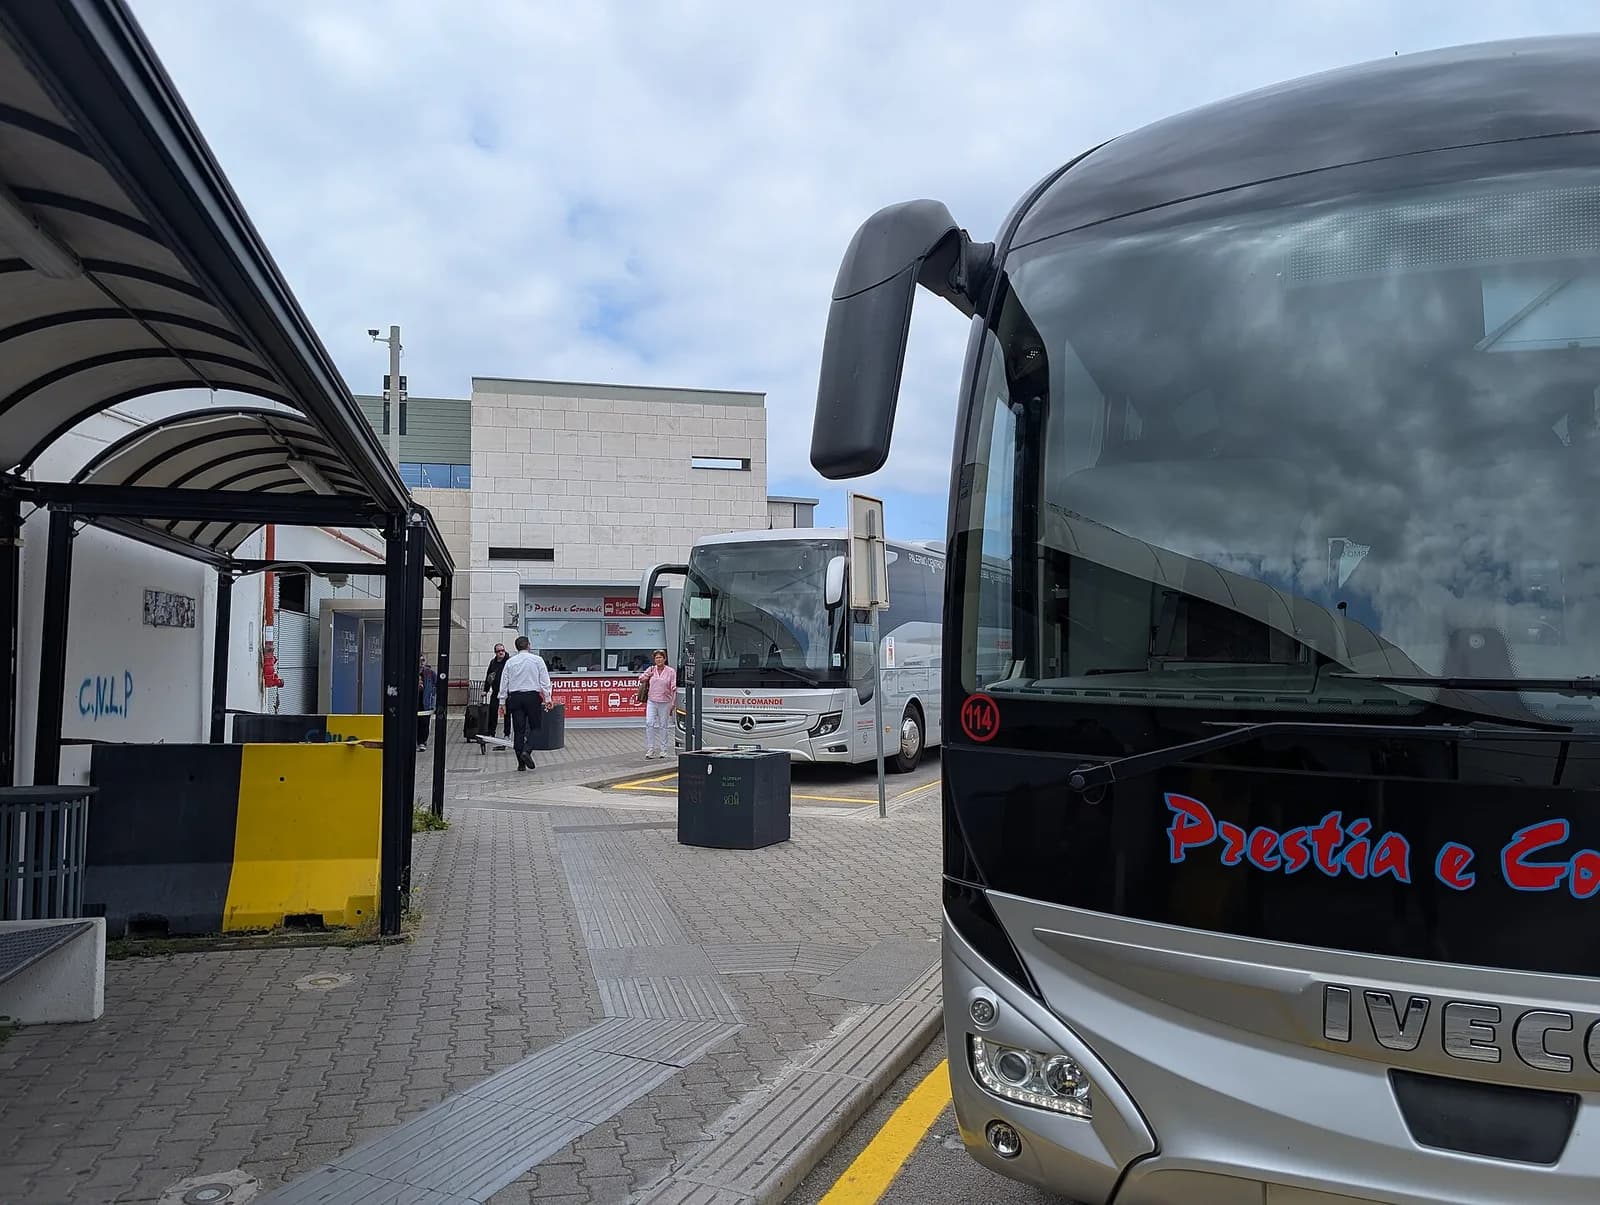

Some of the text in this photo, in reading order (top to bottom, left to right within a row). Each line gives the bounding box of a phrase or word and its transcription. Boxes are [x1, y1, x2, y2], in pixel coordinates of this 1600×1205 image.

[551, 680, 641, 688] HUTTLE BUS TO PALER
[966, 703, 993, 730] 114
[1164, 793, 1411, 884] Prestia
[1435, 841, 1475, 891] e
[1323, 984, 1600, 1073] IVEC
